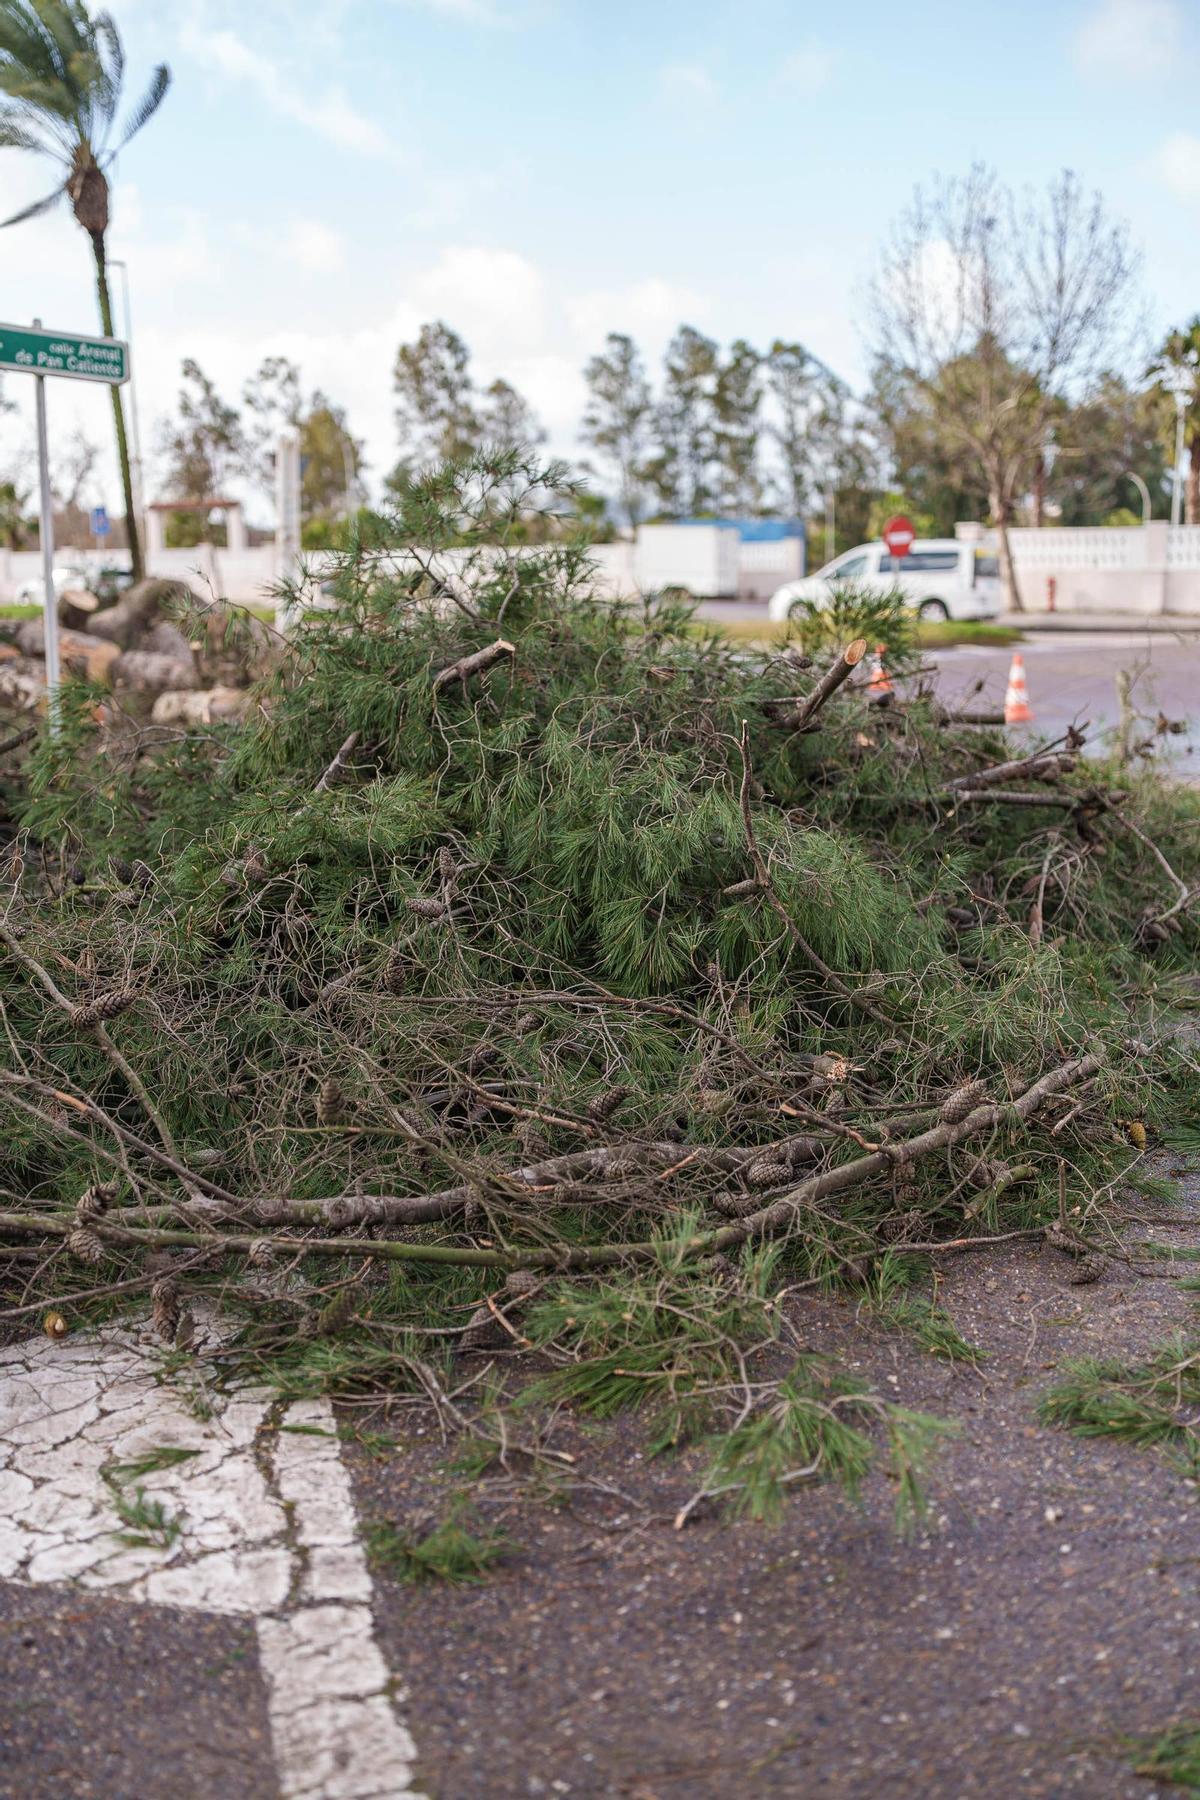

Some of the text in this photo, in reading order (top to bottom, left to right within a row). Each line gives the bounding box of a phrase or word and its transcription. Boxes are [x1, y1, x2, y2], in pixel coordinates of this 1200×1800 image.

[15, 349, 121, 375] de Pan Caliente
[49, 343, 121, 361] calle Arenal
